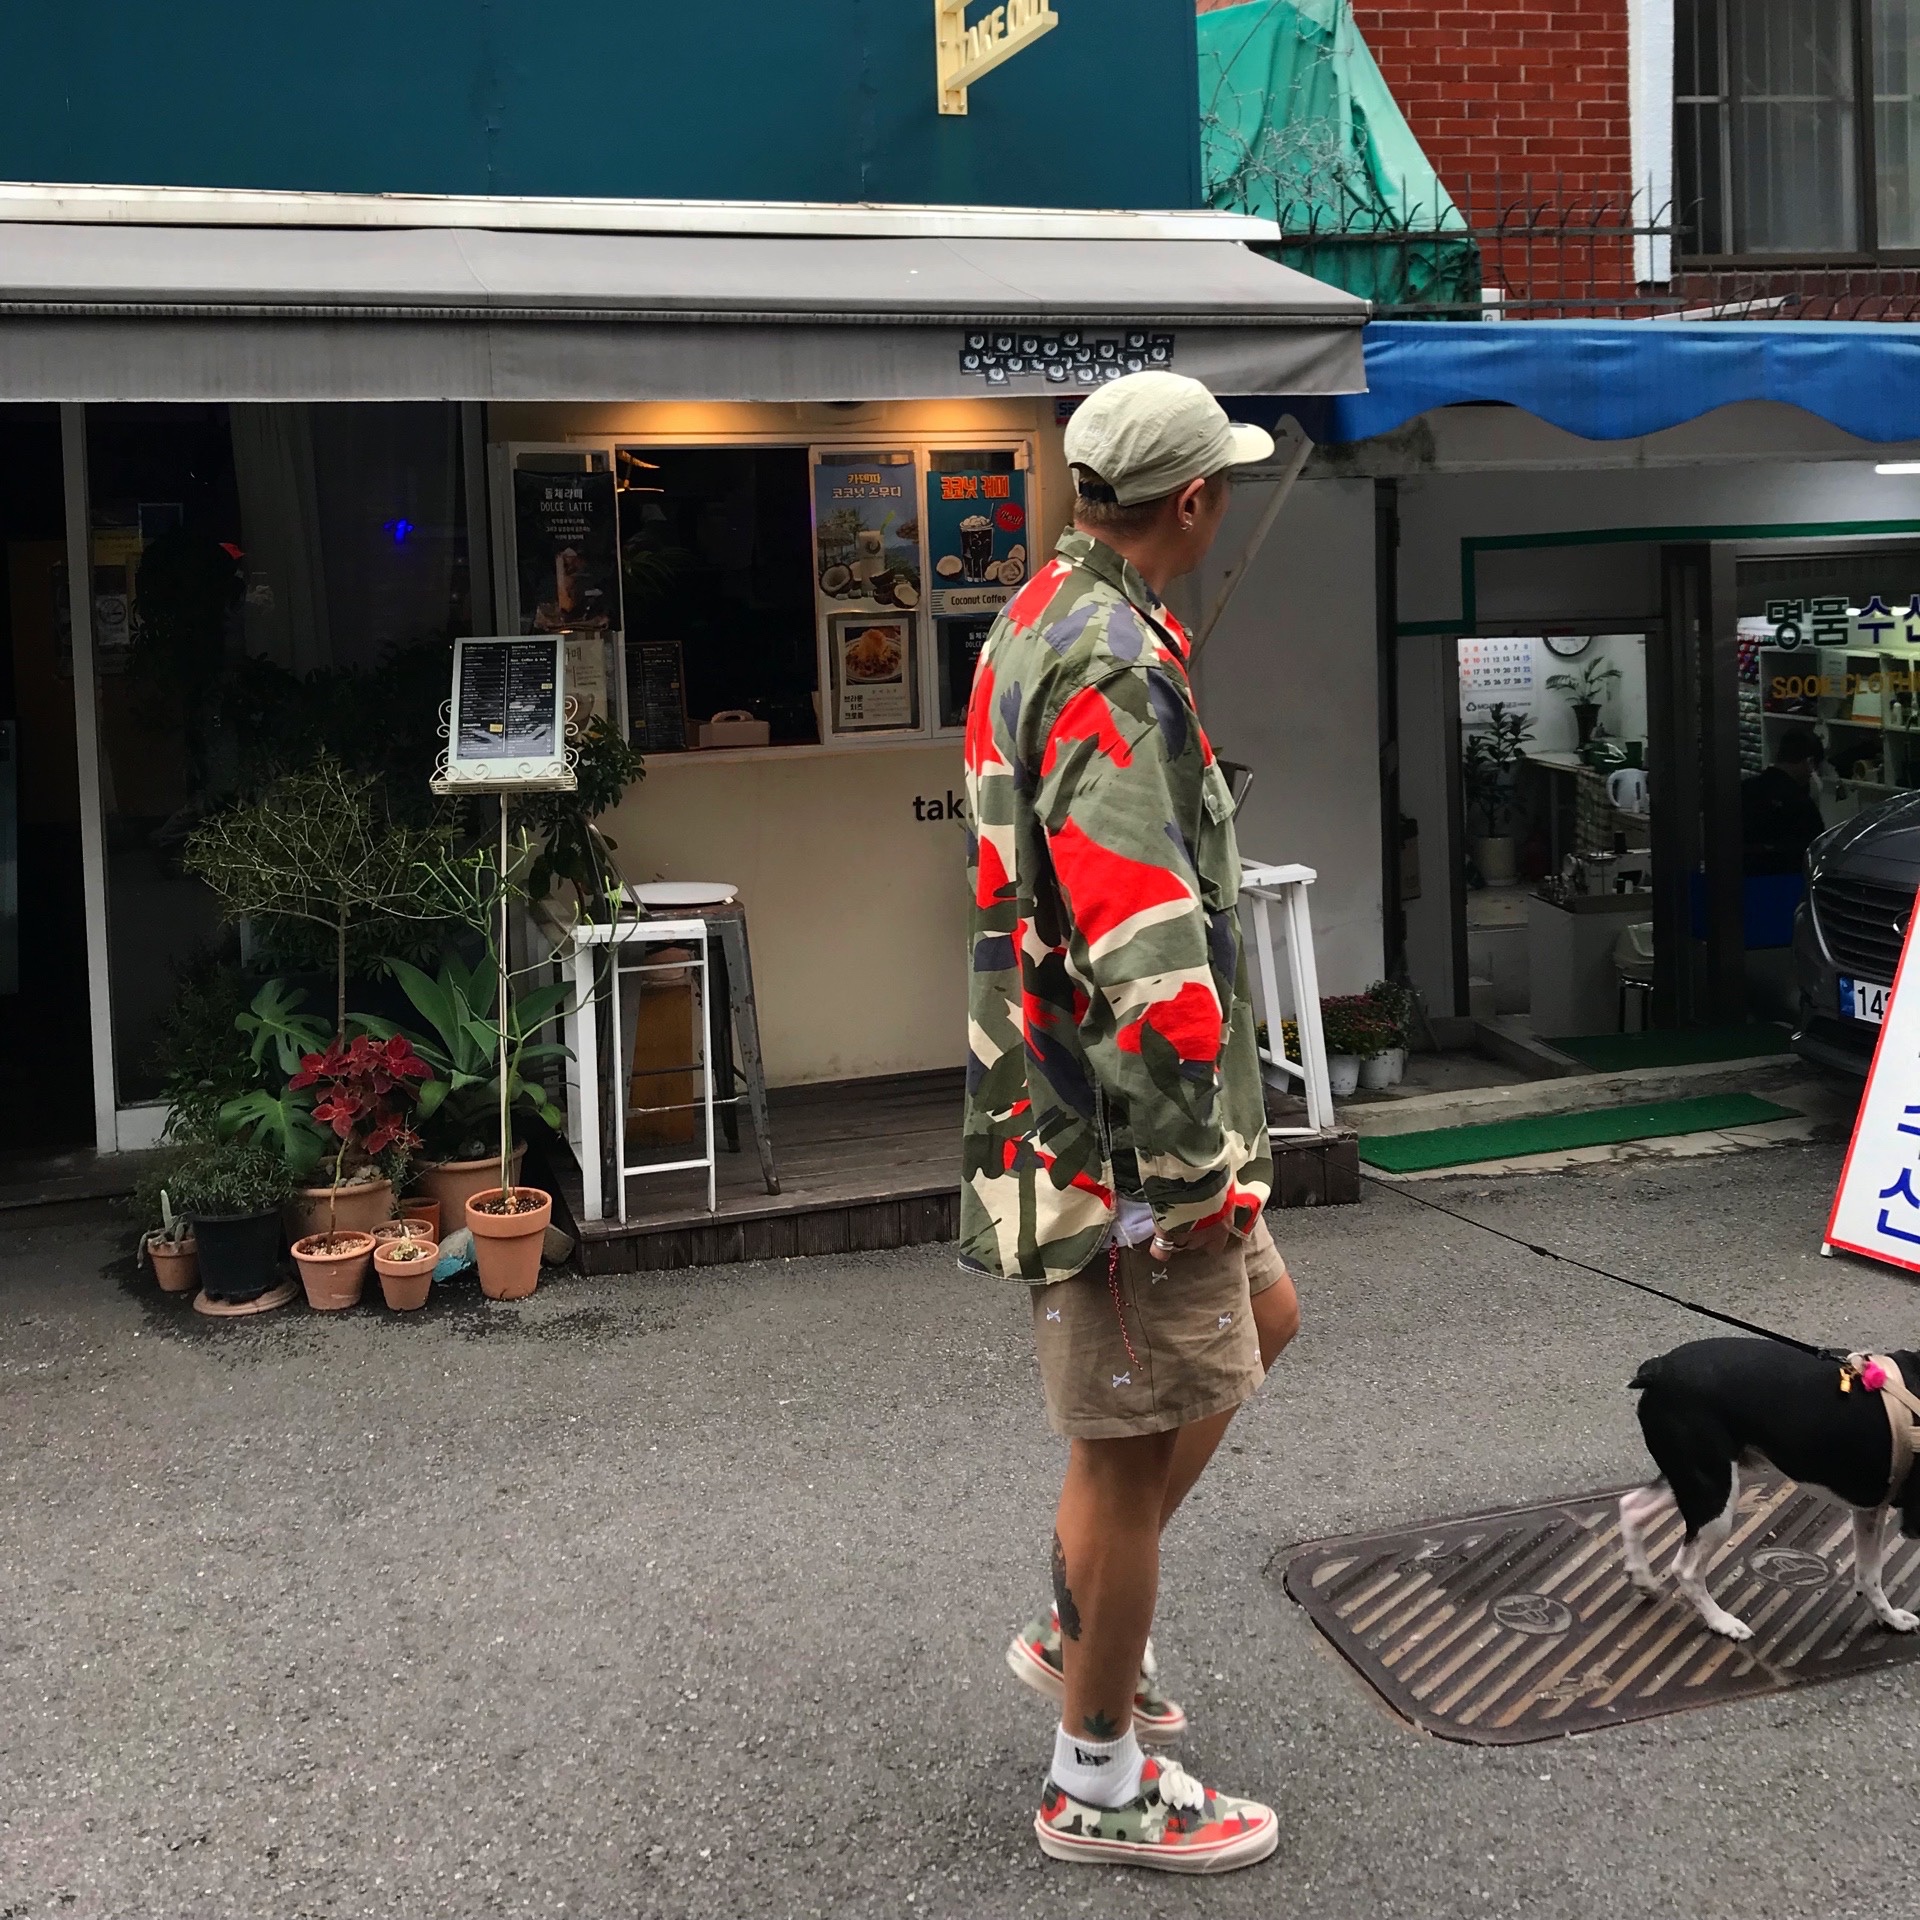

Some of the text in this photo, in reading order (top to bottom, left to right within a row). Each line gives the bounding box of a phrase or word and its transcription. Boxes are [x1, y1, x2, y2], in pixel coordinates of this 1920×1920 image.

[832, 486, 902, 498] 코코넛 스무디
[940, 475, 1010, 500] 코코넛 커피
[540, 501, 593, 512] DOLCE LATTE
[951, 594, 1007, 606] Coconut Coffee
[913, 790, 965, 820] tak
